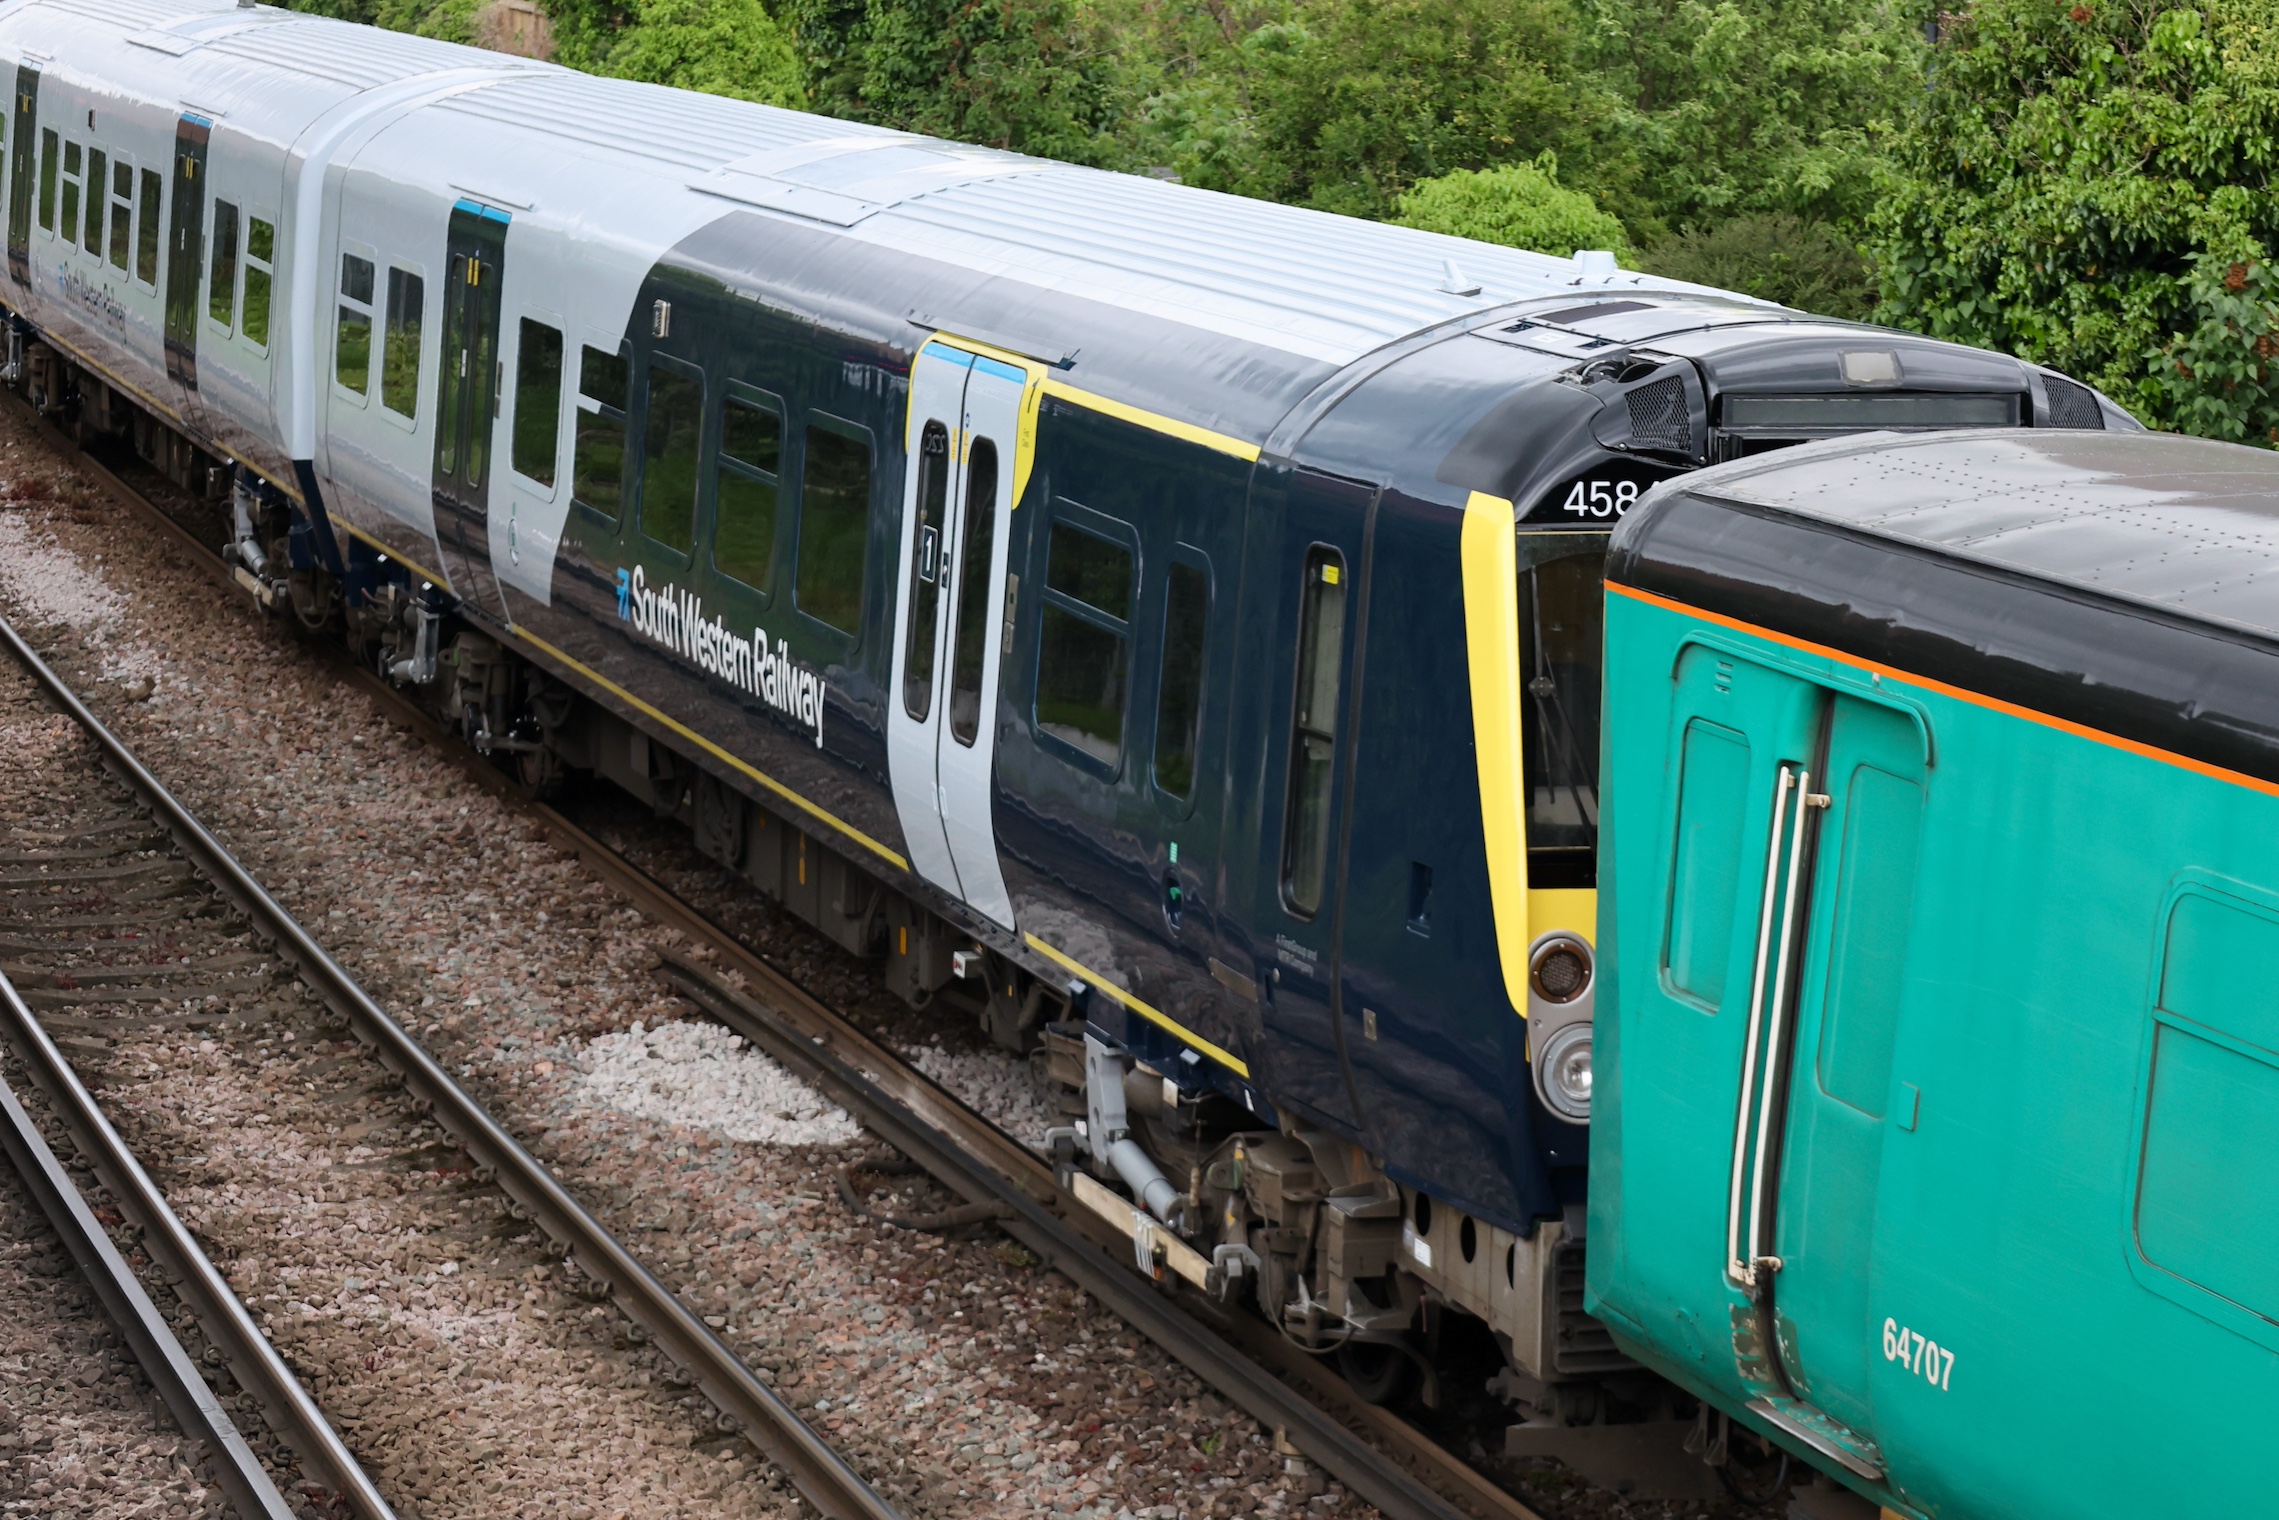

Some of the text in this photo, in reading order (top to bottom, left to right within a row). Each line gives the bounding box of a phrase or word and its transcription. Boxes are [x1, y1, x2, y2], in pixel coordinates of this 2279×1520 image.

[1563, 480, 1660, 517] 458
[926, 535, 933, 571] 1
[632, 565, 826, 749] South Western Railway
[1883, 1317, 1955, 1391] 64707
